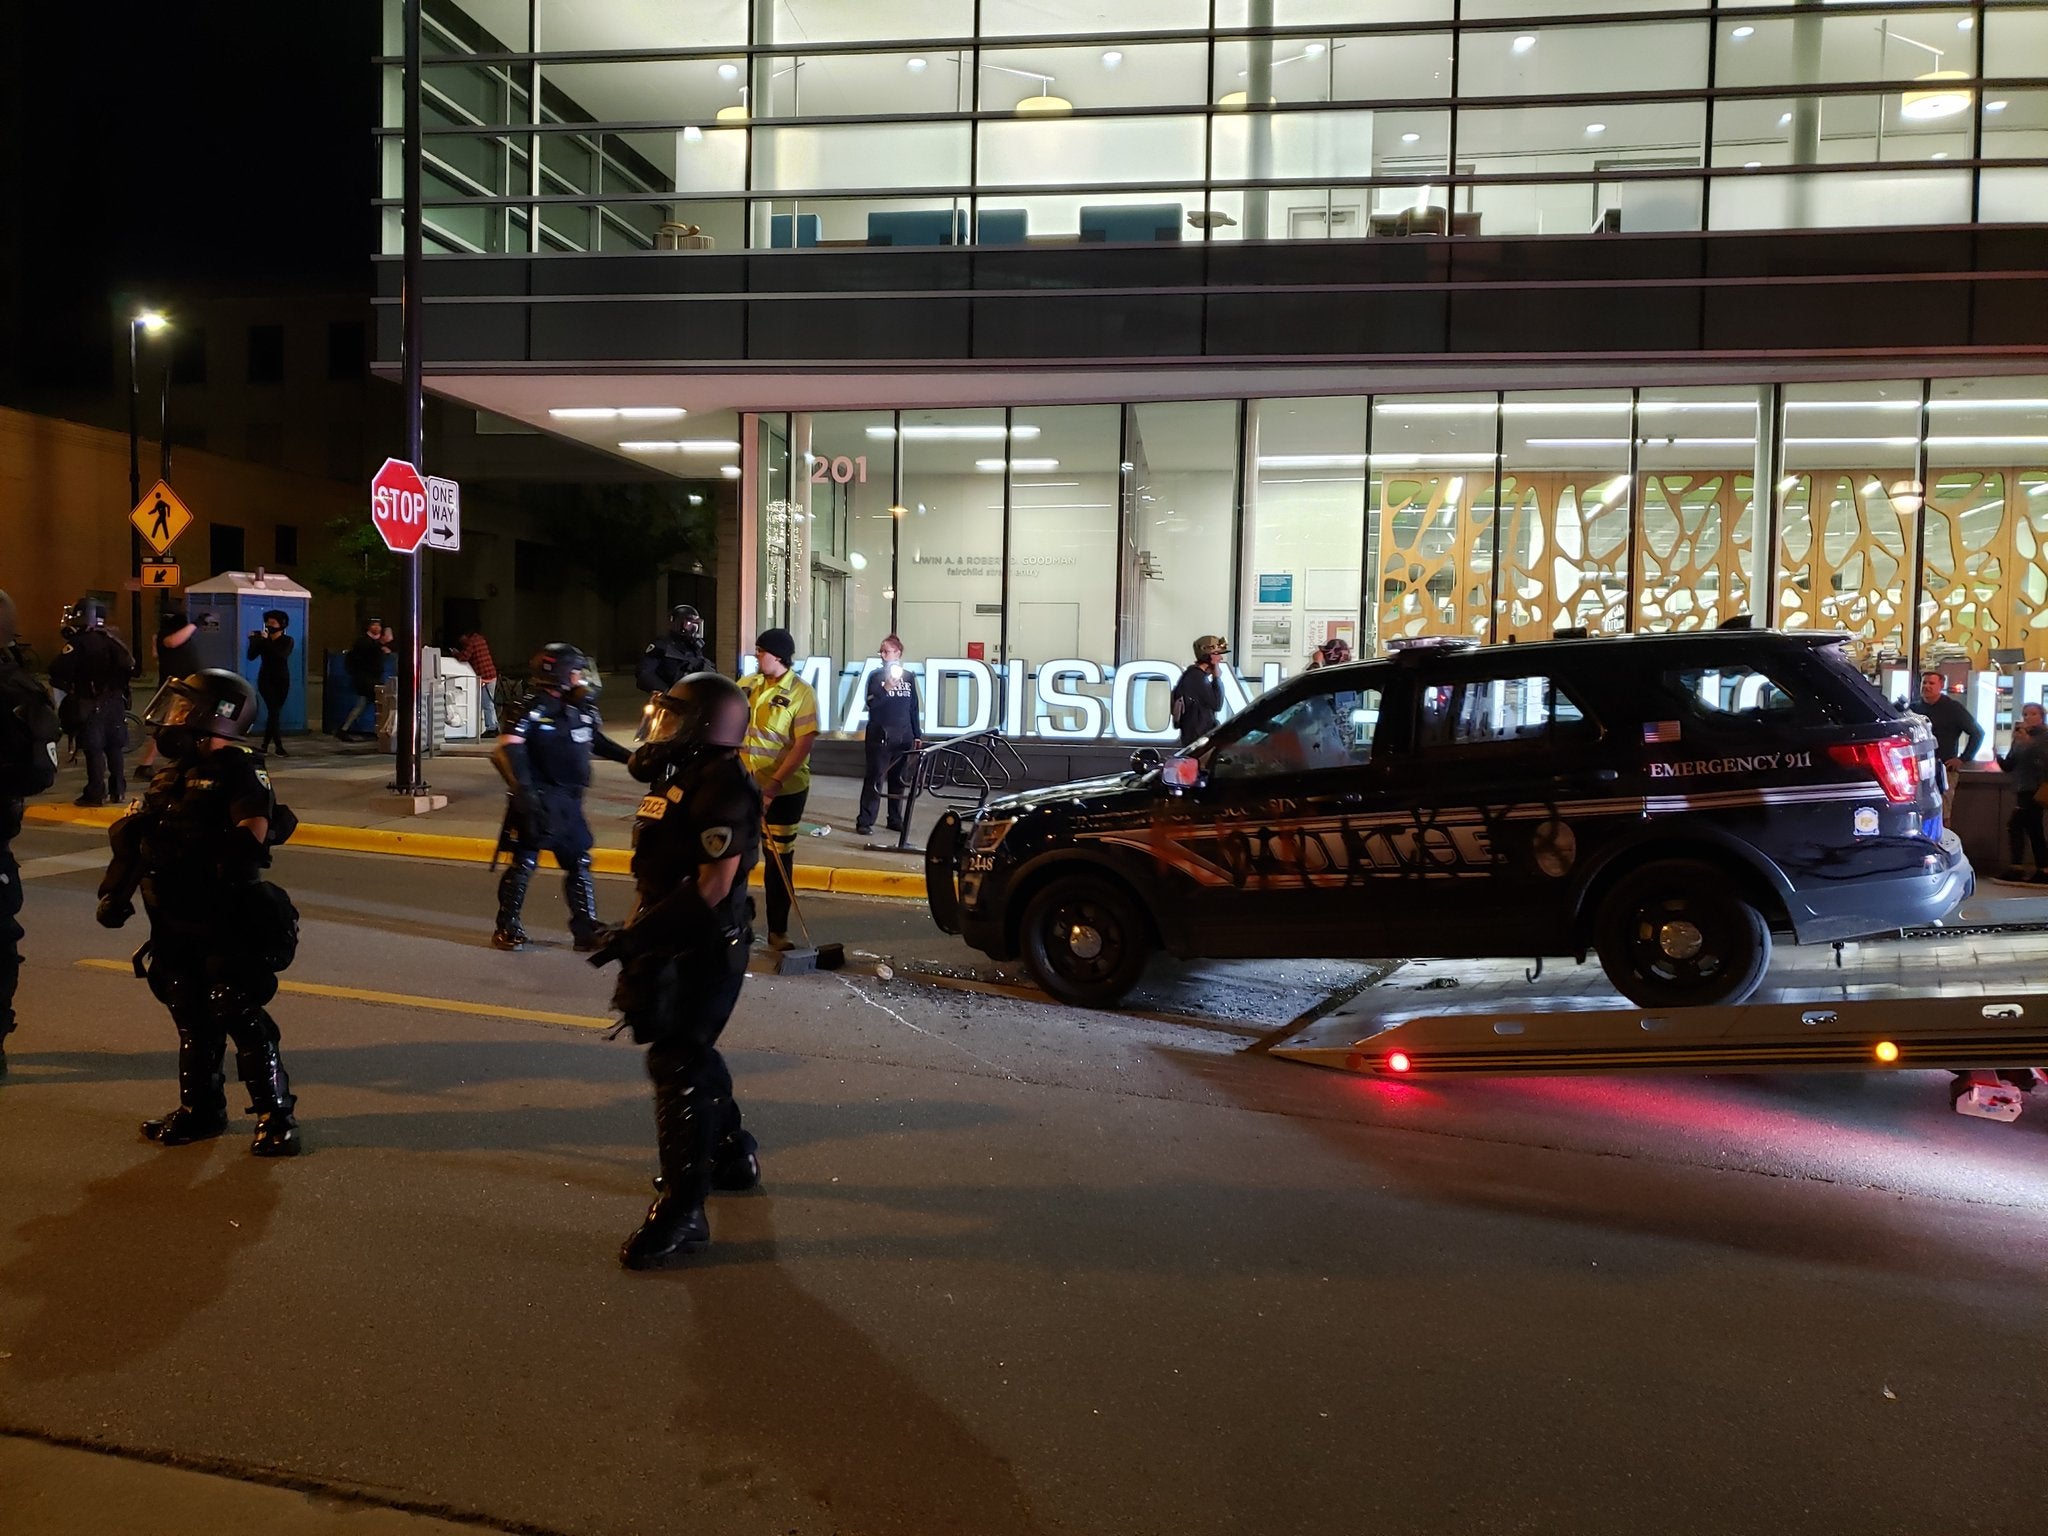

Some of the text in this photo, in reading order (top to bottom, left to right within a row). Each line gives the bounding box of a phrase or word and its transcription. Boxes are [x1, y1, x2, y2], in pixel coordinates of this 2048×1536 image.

[811, 455, 867, 484] 201
[432, 485, 454, 504] ONE
[376, 485, 425, 525] STOP
[432, 504, 454, 523] WAY
[967, 556, 1005, 565] ROBER
[1023, 556, 1076, 566] GOODMAN
[947, 567, 983, 576] fairchild
[1650, 751, 1812, 777] EMERGENCY 911
[969, 856, 994, 871] 2448
